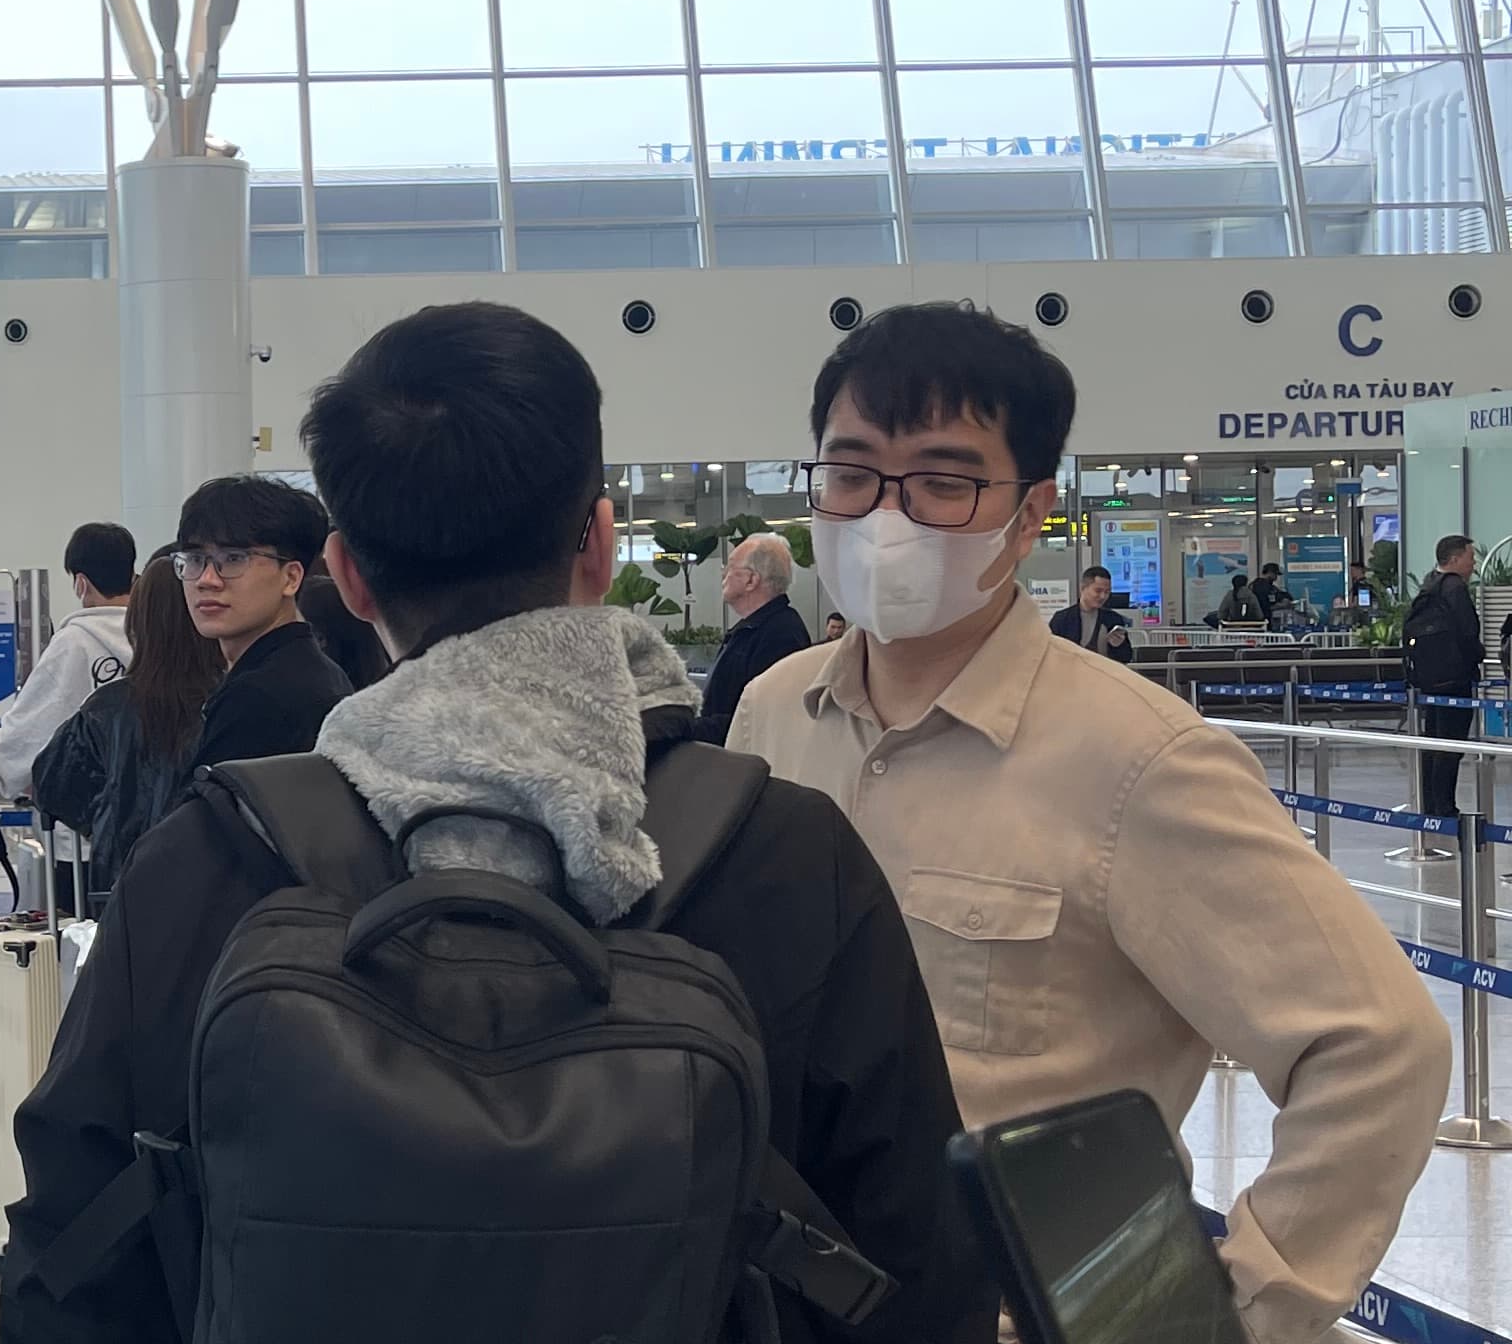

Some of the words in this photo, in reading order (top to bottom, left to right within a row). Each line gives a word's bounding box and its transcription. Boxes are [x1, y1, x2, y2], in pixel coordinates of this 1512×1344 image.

[1338, 304, 1383, 357] C
[1285, 378, 1327, 400] CỬA
[1333, 383, 1361, 399] RA
[1366, 378, 1407, 398] TÀU
[1413, 381, 1454, 398] BAY
[1219, 410, 1404, 439] DEPARTUR
[1470, 406, 1512, 431] RECH
[1283, 793, 1299, 807] ACV
[1327, 801, 1344, 815] ACV
[1374, 810, 1391, 825] ACV
[1423, 817, 1441, 831] ACV
[1409, 949, 1432, 970] ACV
[1472, 967, 1497, 989] ACV
